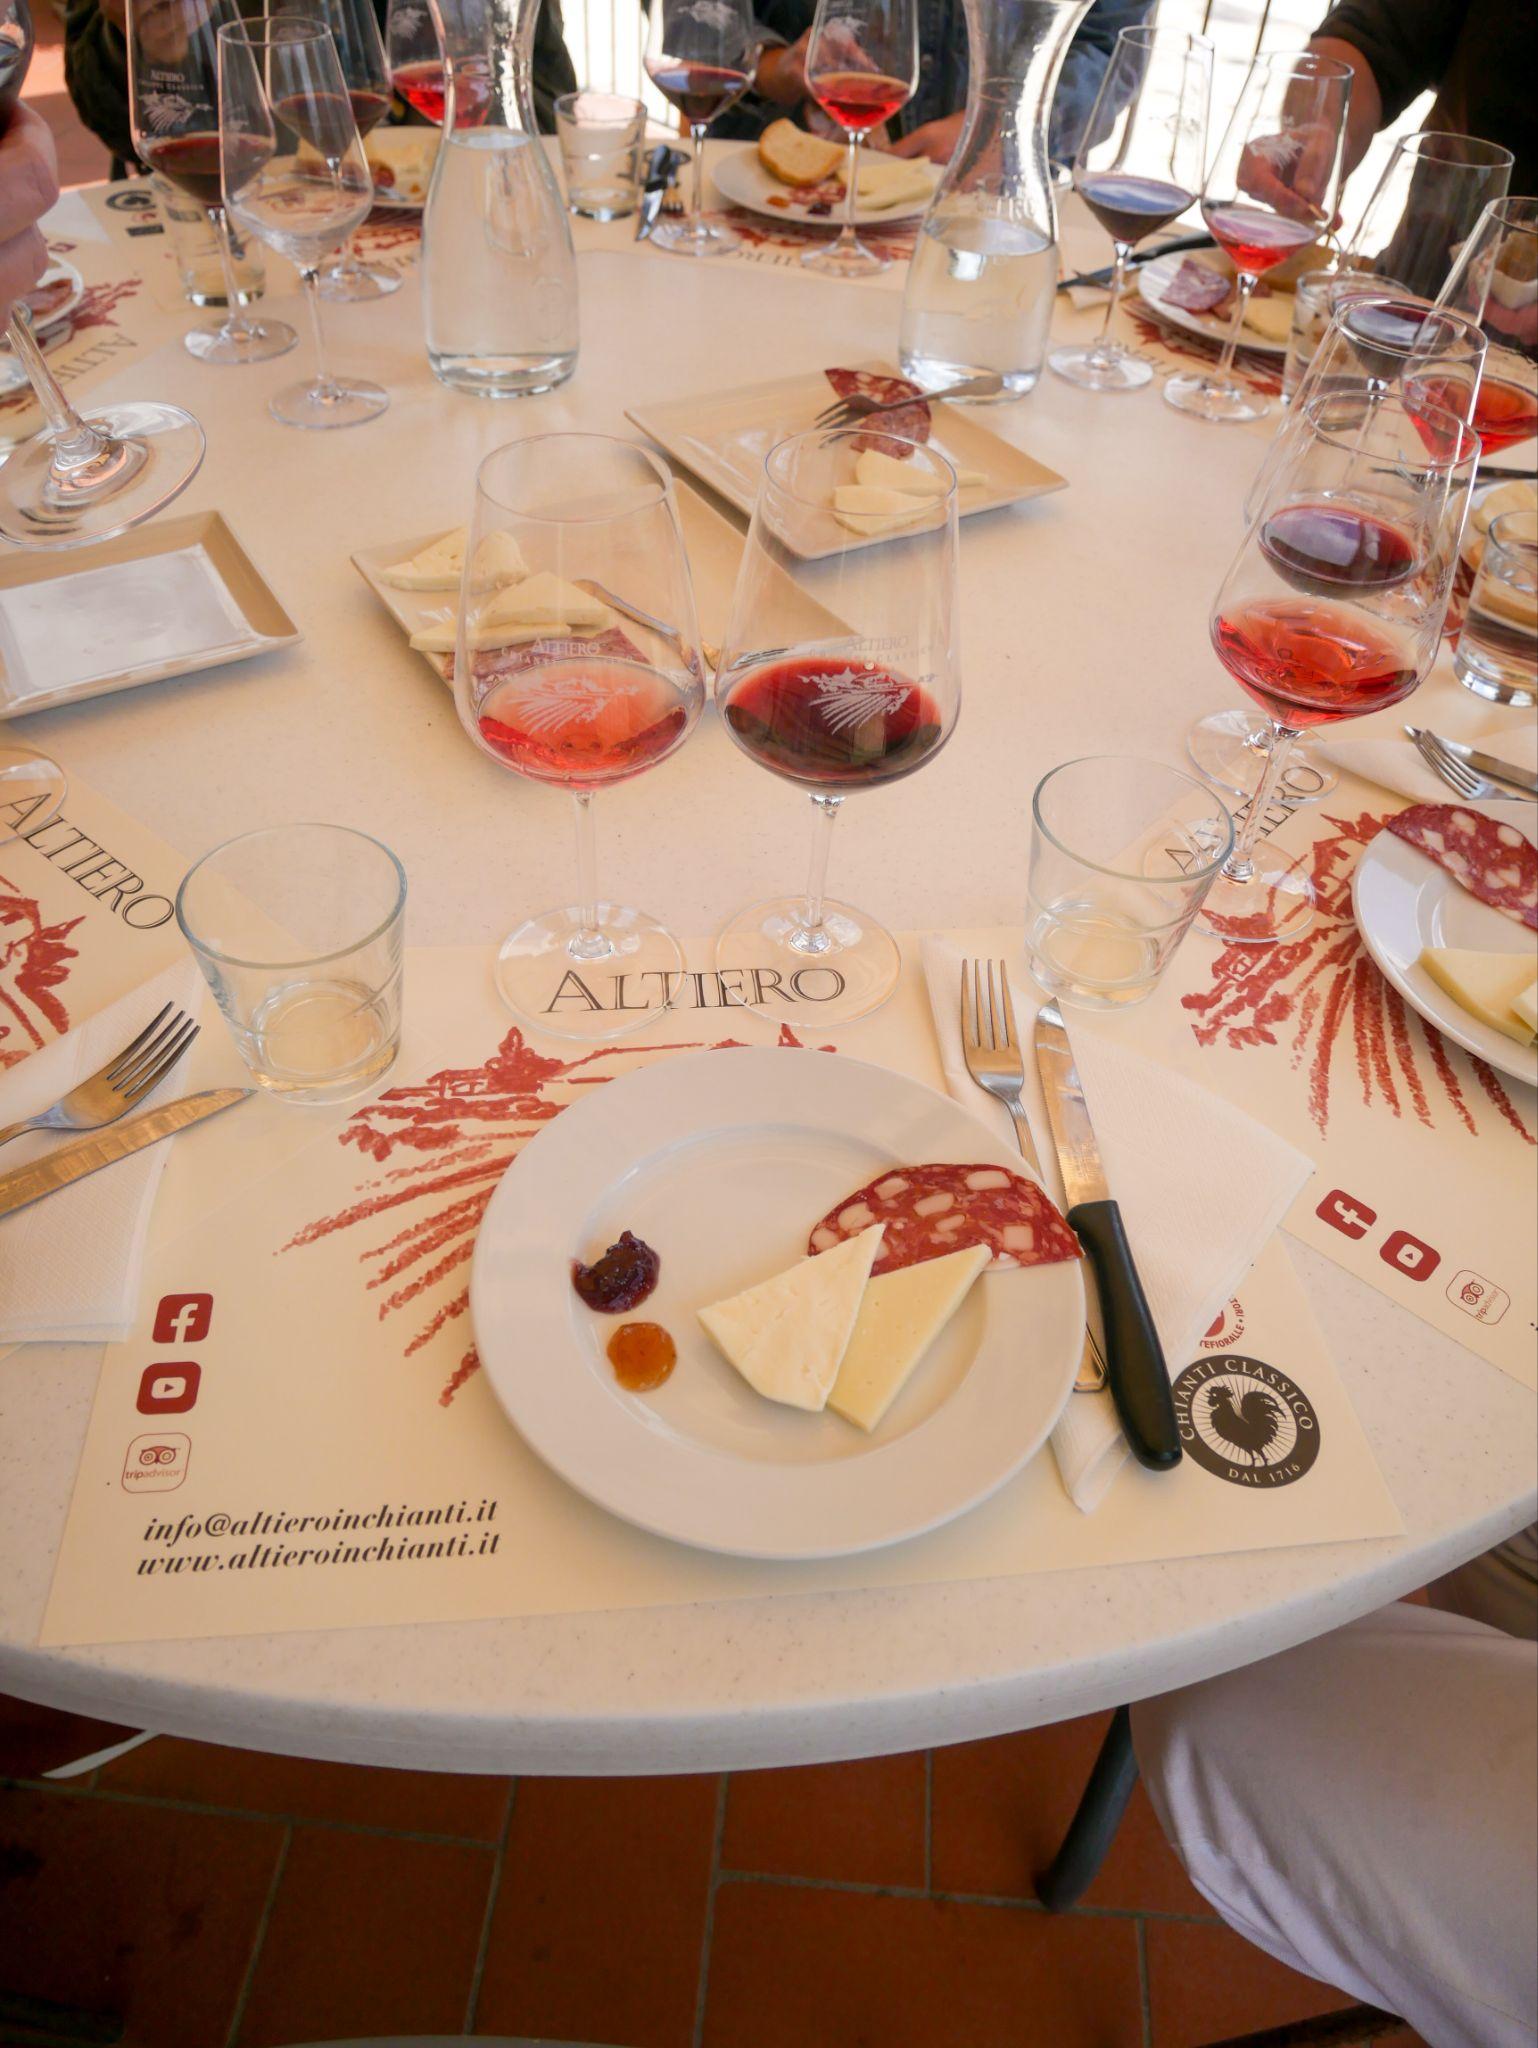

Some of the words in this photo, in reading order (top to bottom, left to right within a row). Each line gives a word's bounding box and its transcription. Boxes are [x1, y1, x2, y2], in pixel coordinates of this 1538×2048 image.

[0, 792, 175, 930] ALTIERO
[538, 967, 846, 1014] ALTIERO
[1175, 1362, 1216, 1441] CHIANTI
[1224, 1359, 1313, 1430] CLASSICO
[125, 1469, 181, 1480] tripadvisor
[1228, 1468, 1262, 1484] DAL
[1269, 1463, 1301, 1482] 1716
[143, 1499, 498, 1548] info@altieroinchianti.it
[137, 1532, 500, 1576] www.altieroinchianti.it
